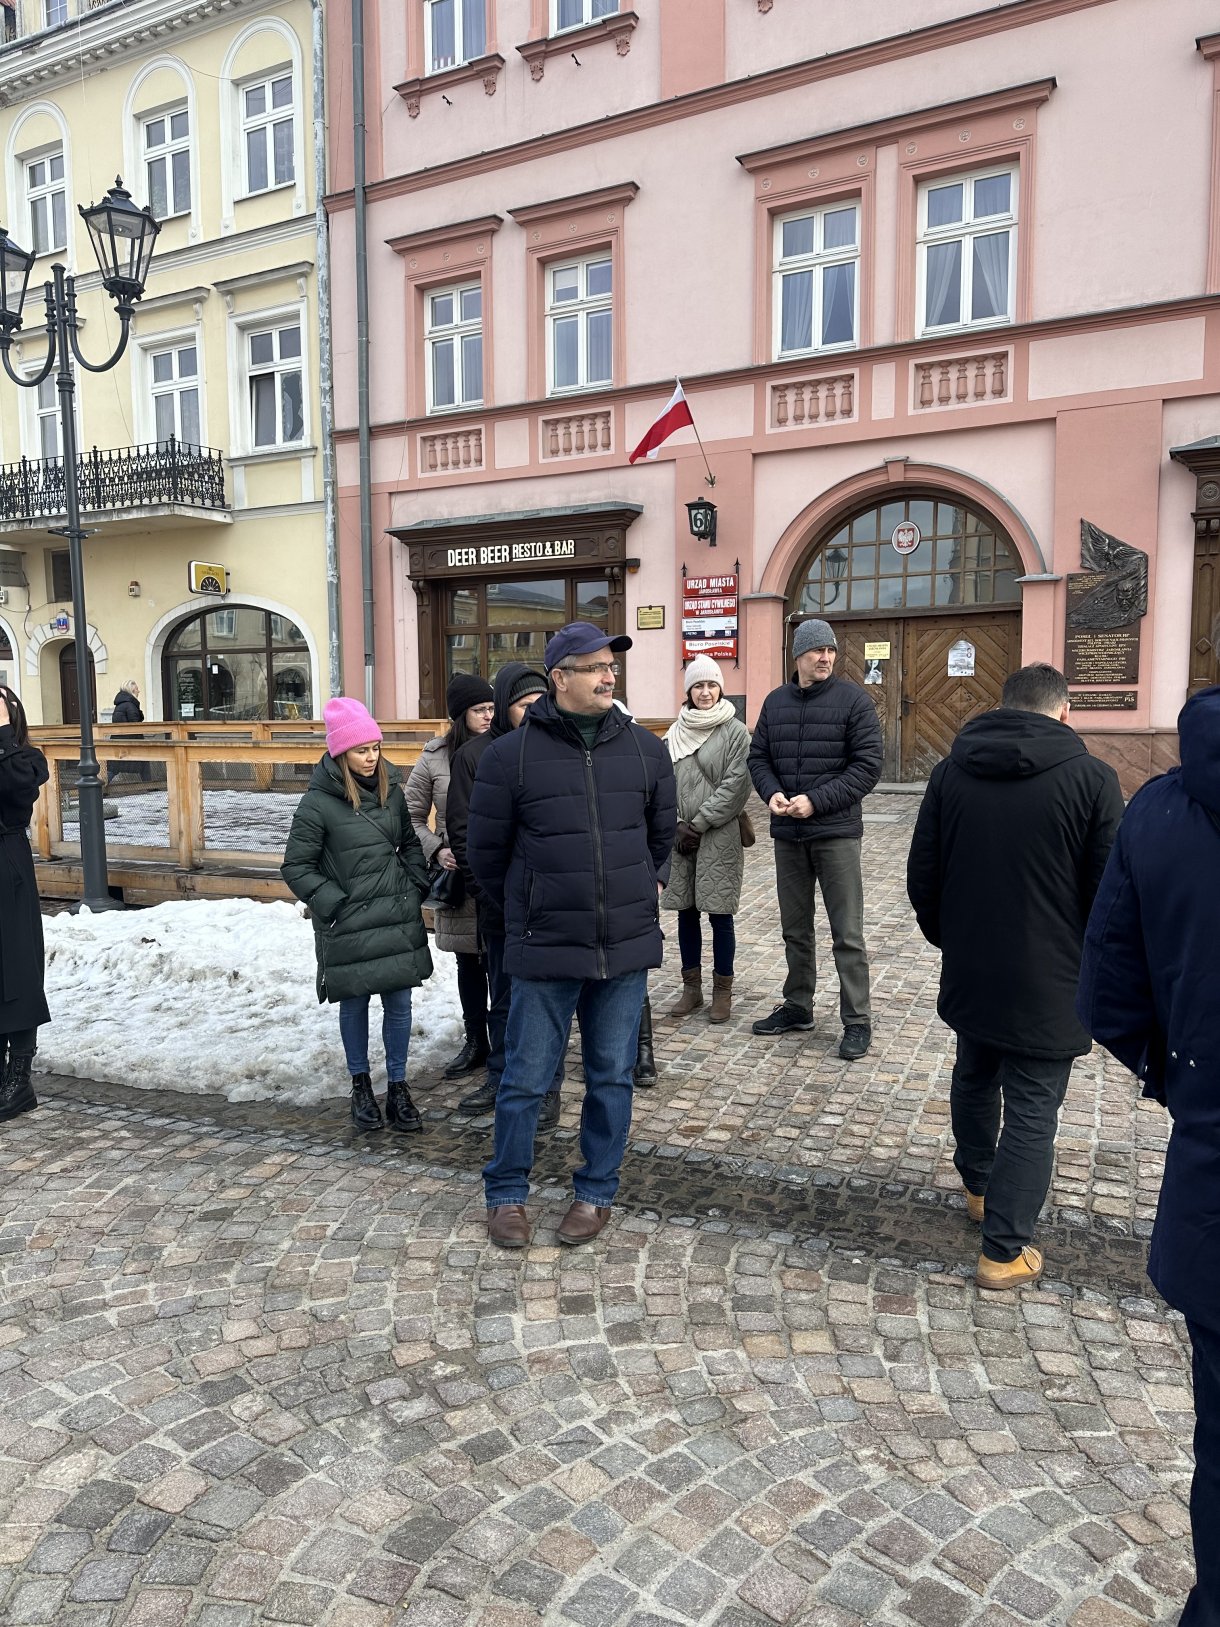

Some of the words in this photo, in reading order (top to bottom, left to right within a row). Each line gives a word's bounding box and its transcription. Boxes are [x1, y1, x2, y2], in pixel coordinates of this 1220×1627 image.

[693, 511, 704, 528] 6
[447, 547, 477, 567] DEER
[480, 545, 510, 565] BEER
[512, 542, 543, 558] RESTO
[544, 541, 553, 555] &
[554, 539, 575, 555] BAR
[686, 578, 707, 590] URZĄD
[709, 576, 735, 588] MIASTA
